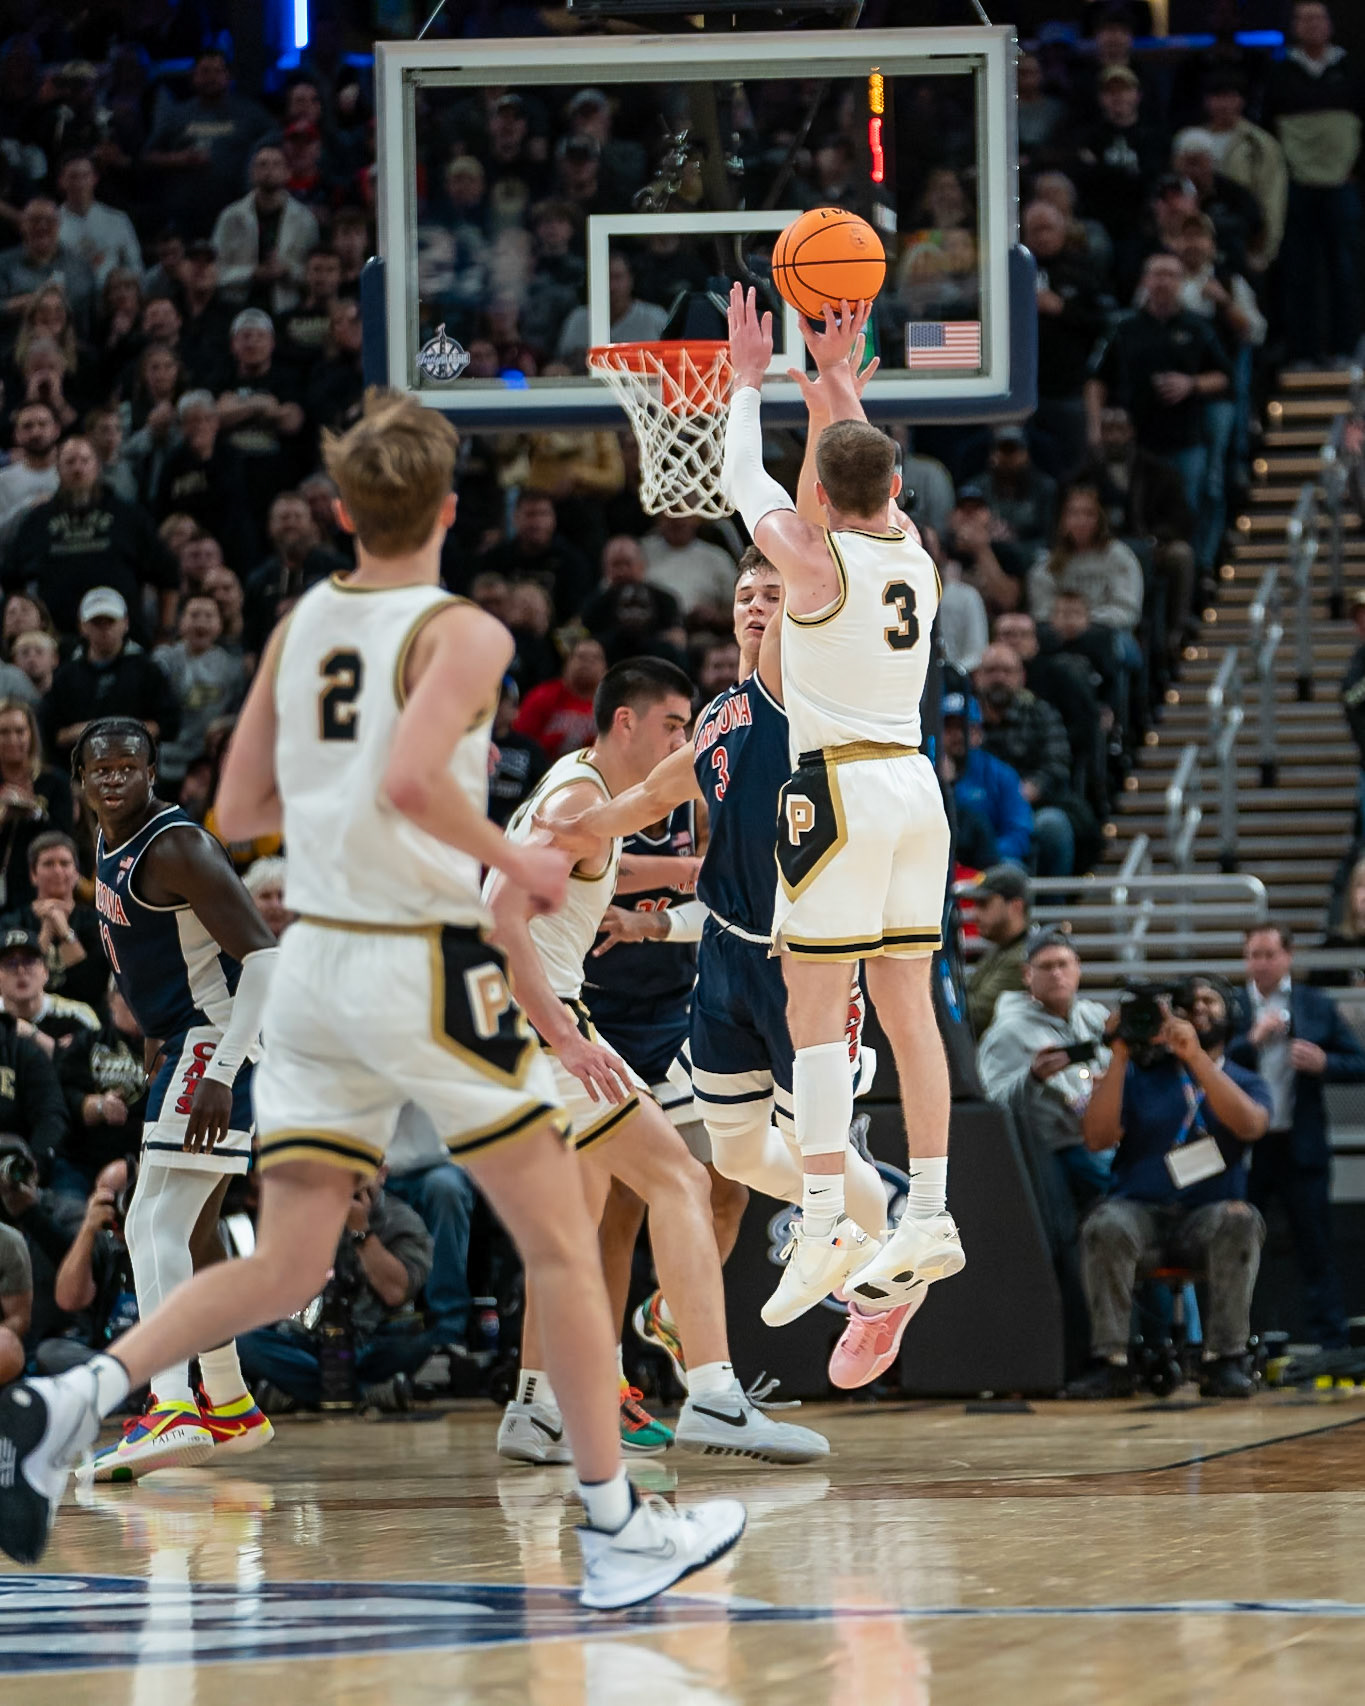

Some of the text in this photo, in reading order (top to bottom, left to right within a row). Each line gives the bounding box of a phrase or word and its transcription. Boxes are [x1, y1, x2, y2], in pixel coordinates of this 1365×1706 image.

[881, 580, 920, 651] 3
[317, 646, 363, 742] 2
[711, 745, 730, 802] 3
[785, 793, 816, 847] P
[463, 961, 512, 1040] P
